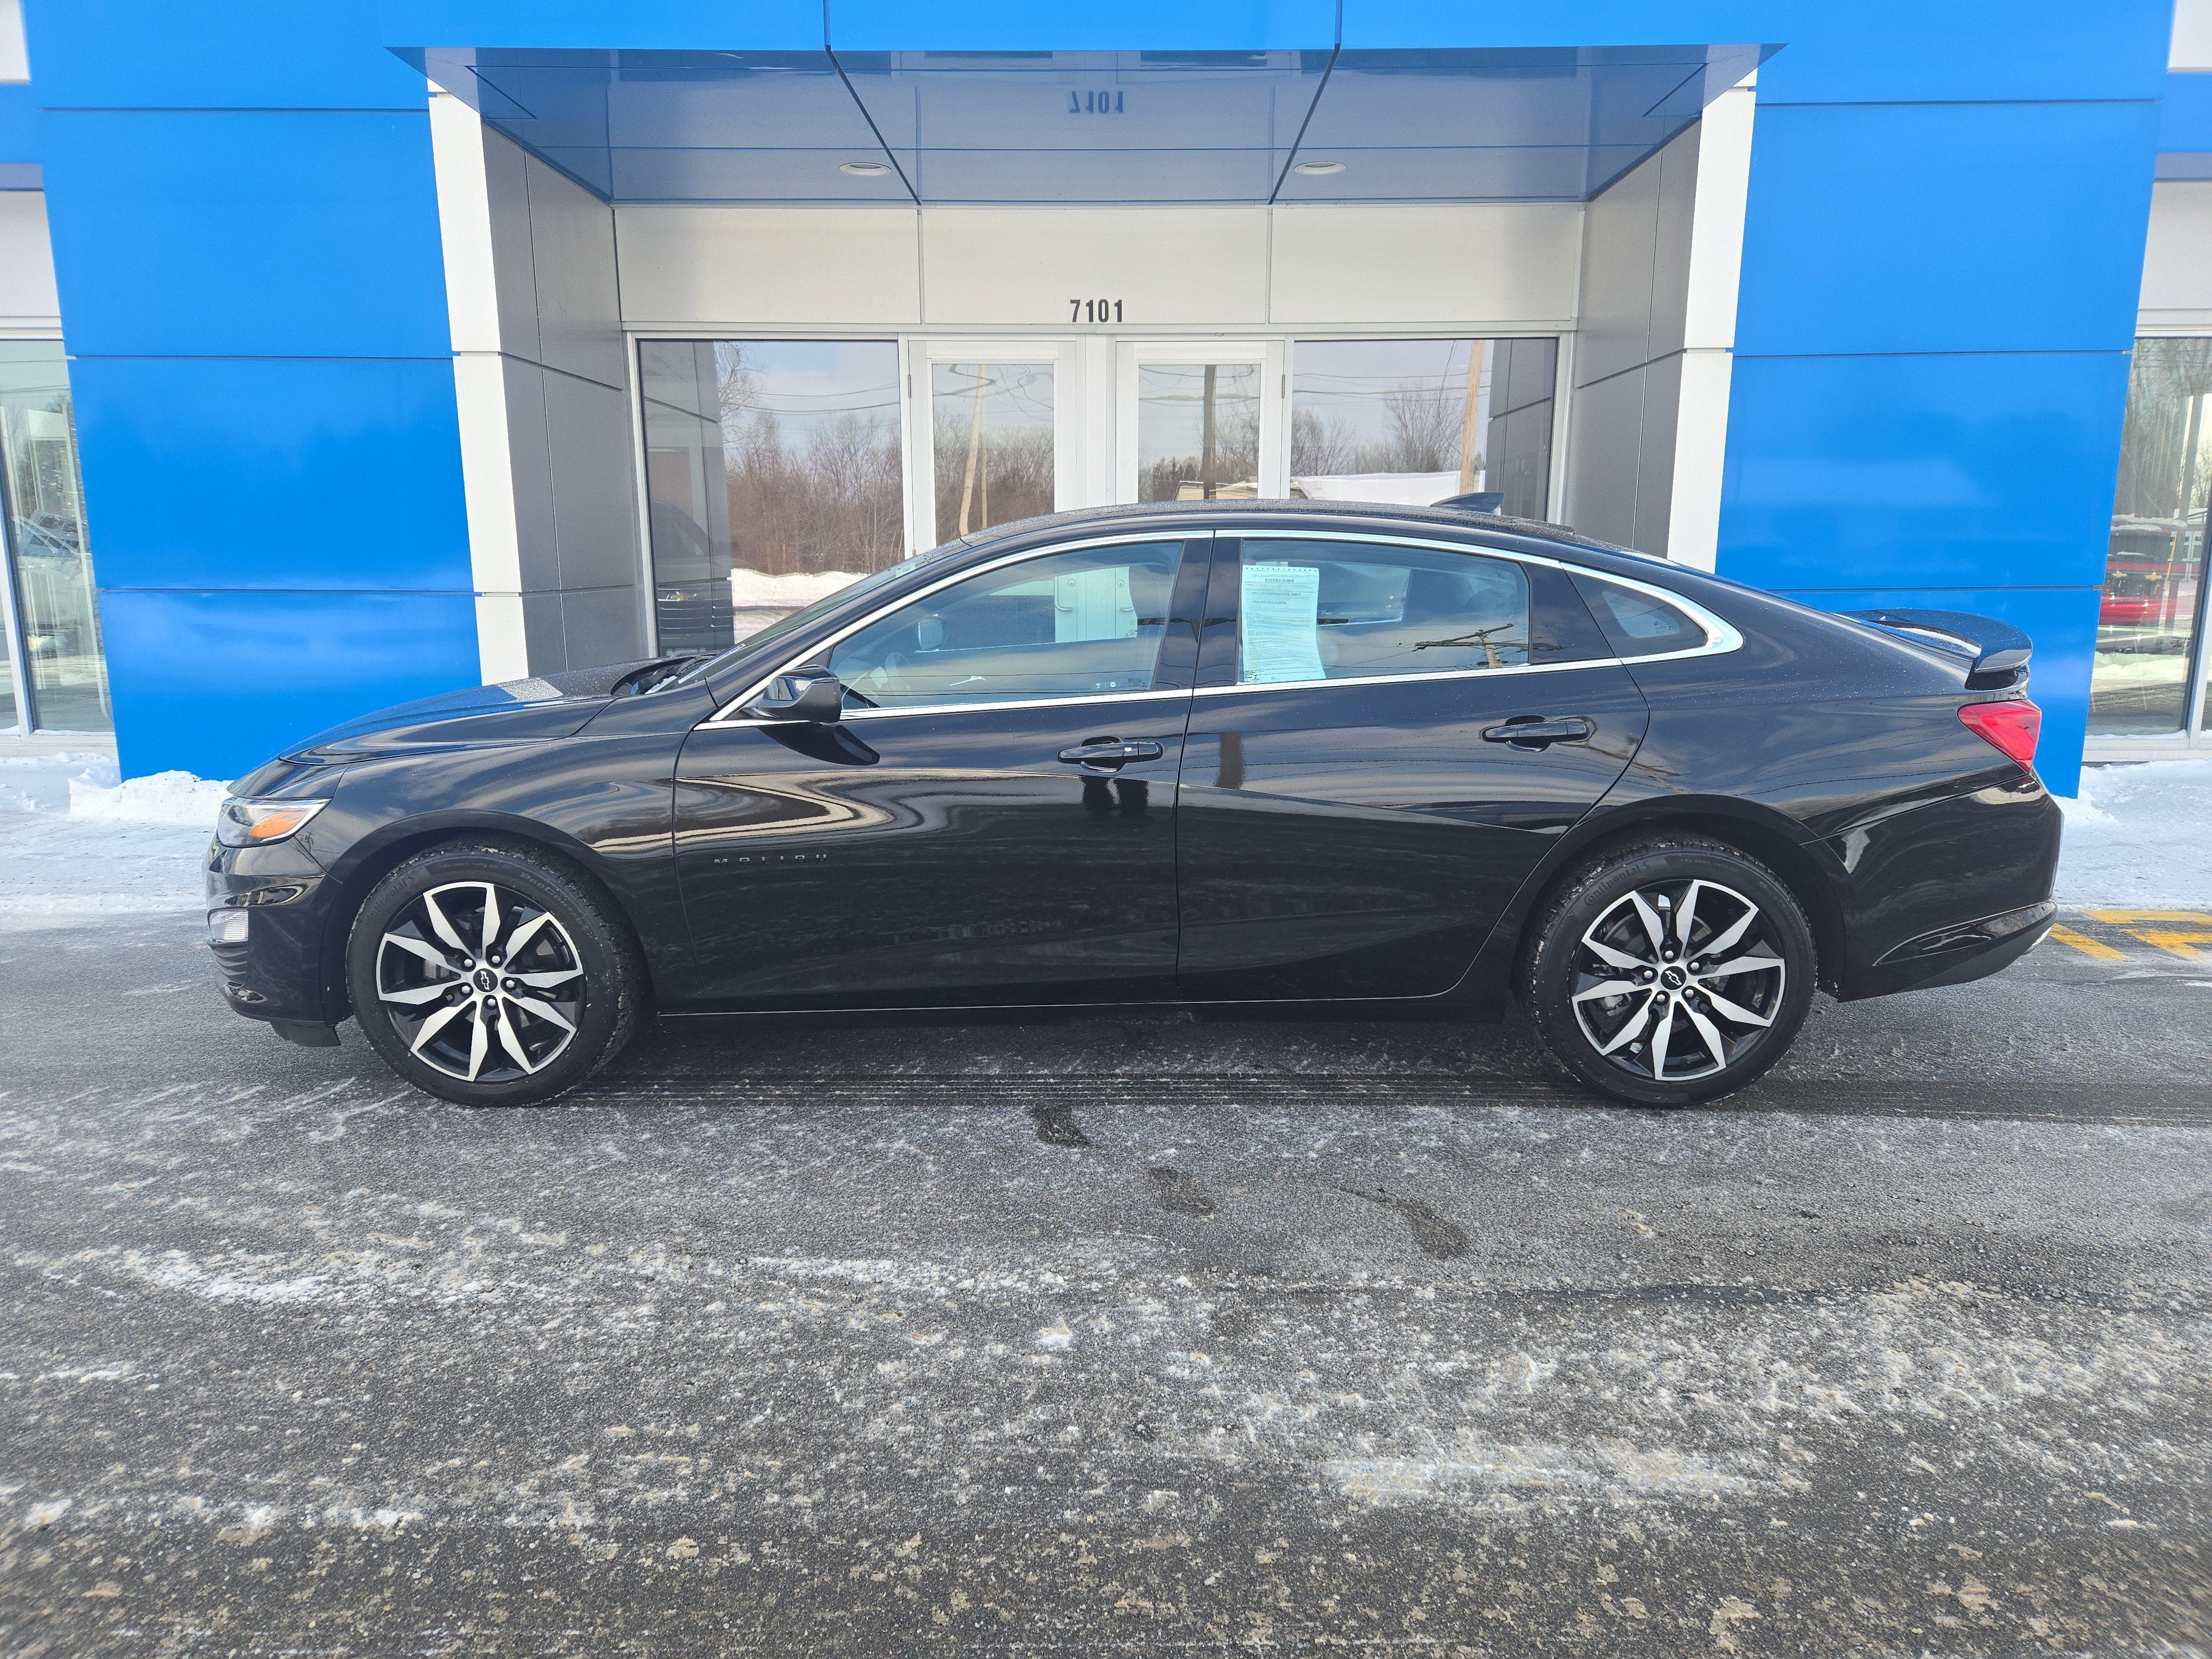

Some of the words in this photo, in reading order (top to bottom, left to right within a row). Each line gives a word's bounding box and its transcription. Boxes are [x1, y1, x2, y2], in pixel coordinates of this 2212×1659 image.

[1070, 299, 1122, 323] 7101
[713, 853, 827, 867] MALIBU
[1584, 864, 1641, 906] Continental
